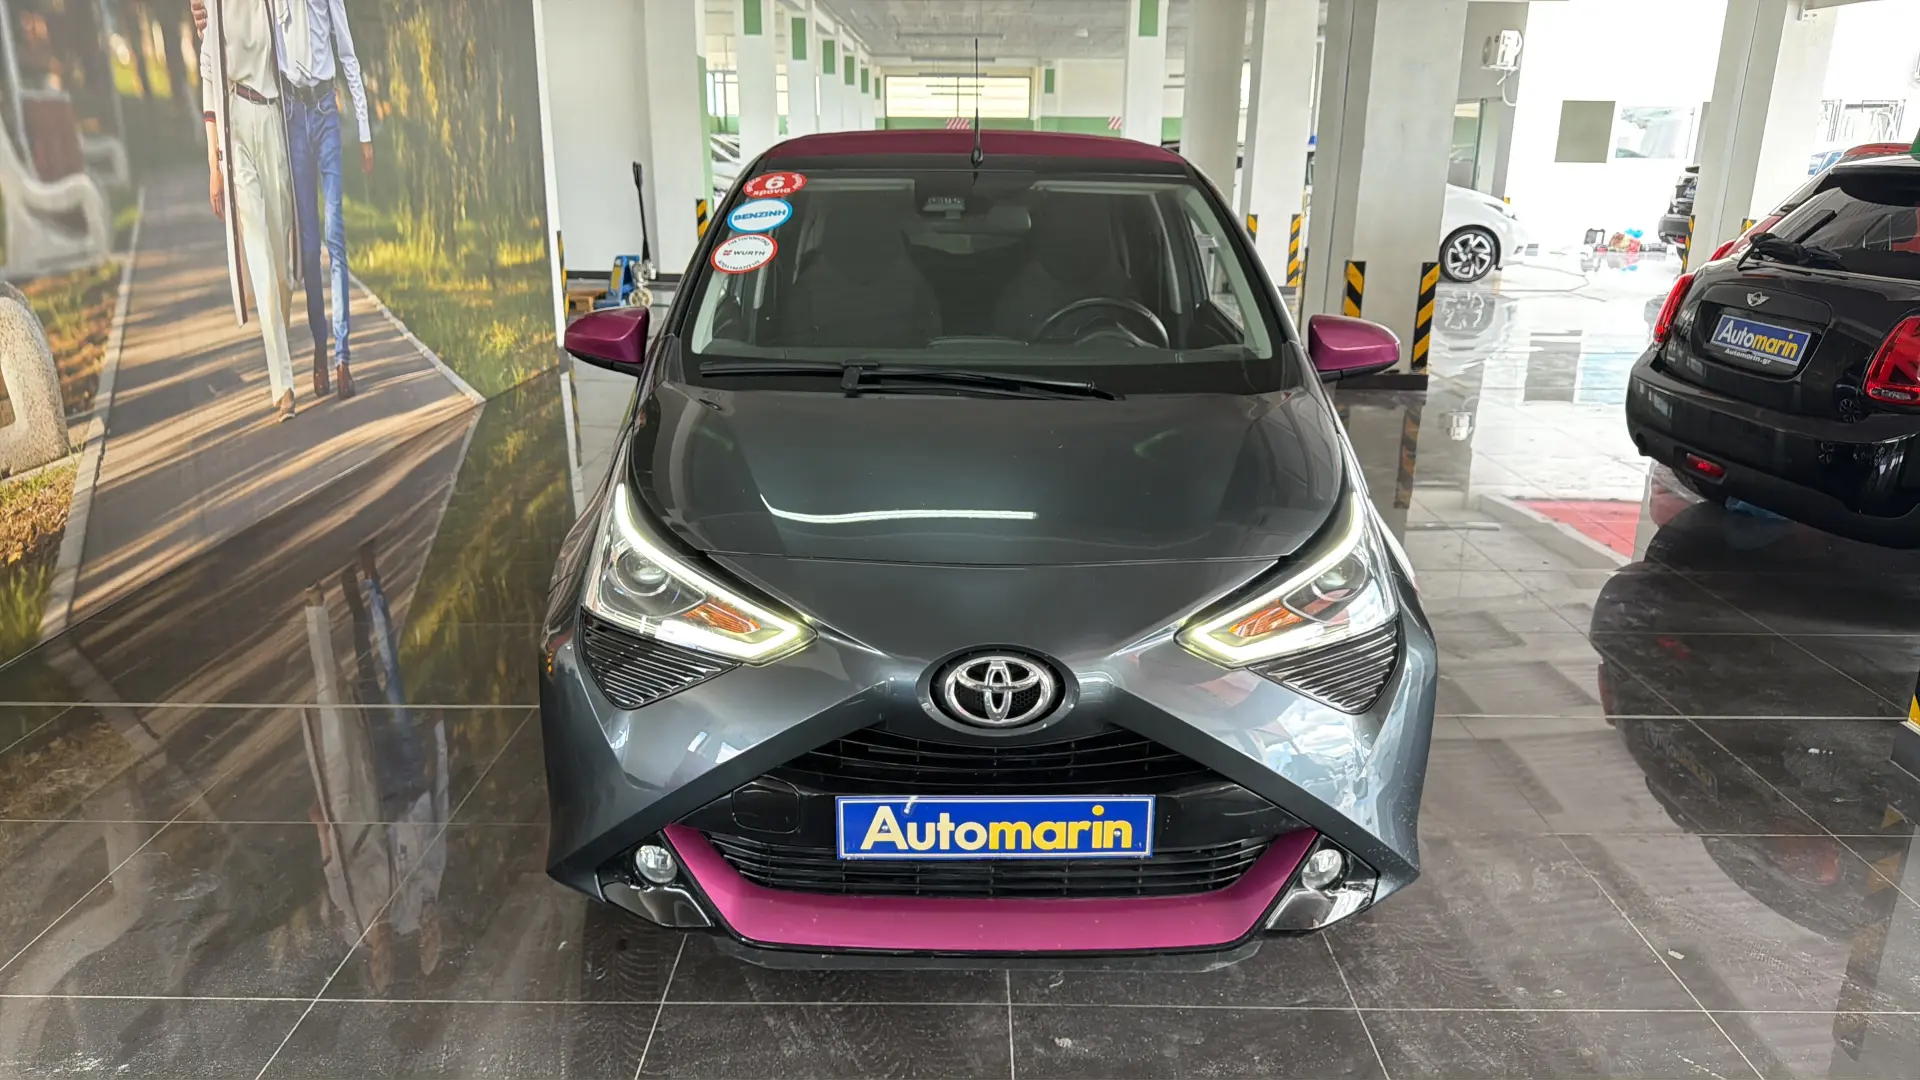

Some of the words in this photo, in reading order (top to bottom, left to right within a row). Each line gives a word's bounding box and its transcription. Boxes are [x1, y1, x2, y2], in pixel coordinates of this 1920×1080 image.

[765, 175, 785, 189] 6
[1717, 319, 1799, 359] Automarin
[1724, 347, 1772, 365] Automarin.gr
[860, 804, 1132, 850] Automarin
